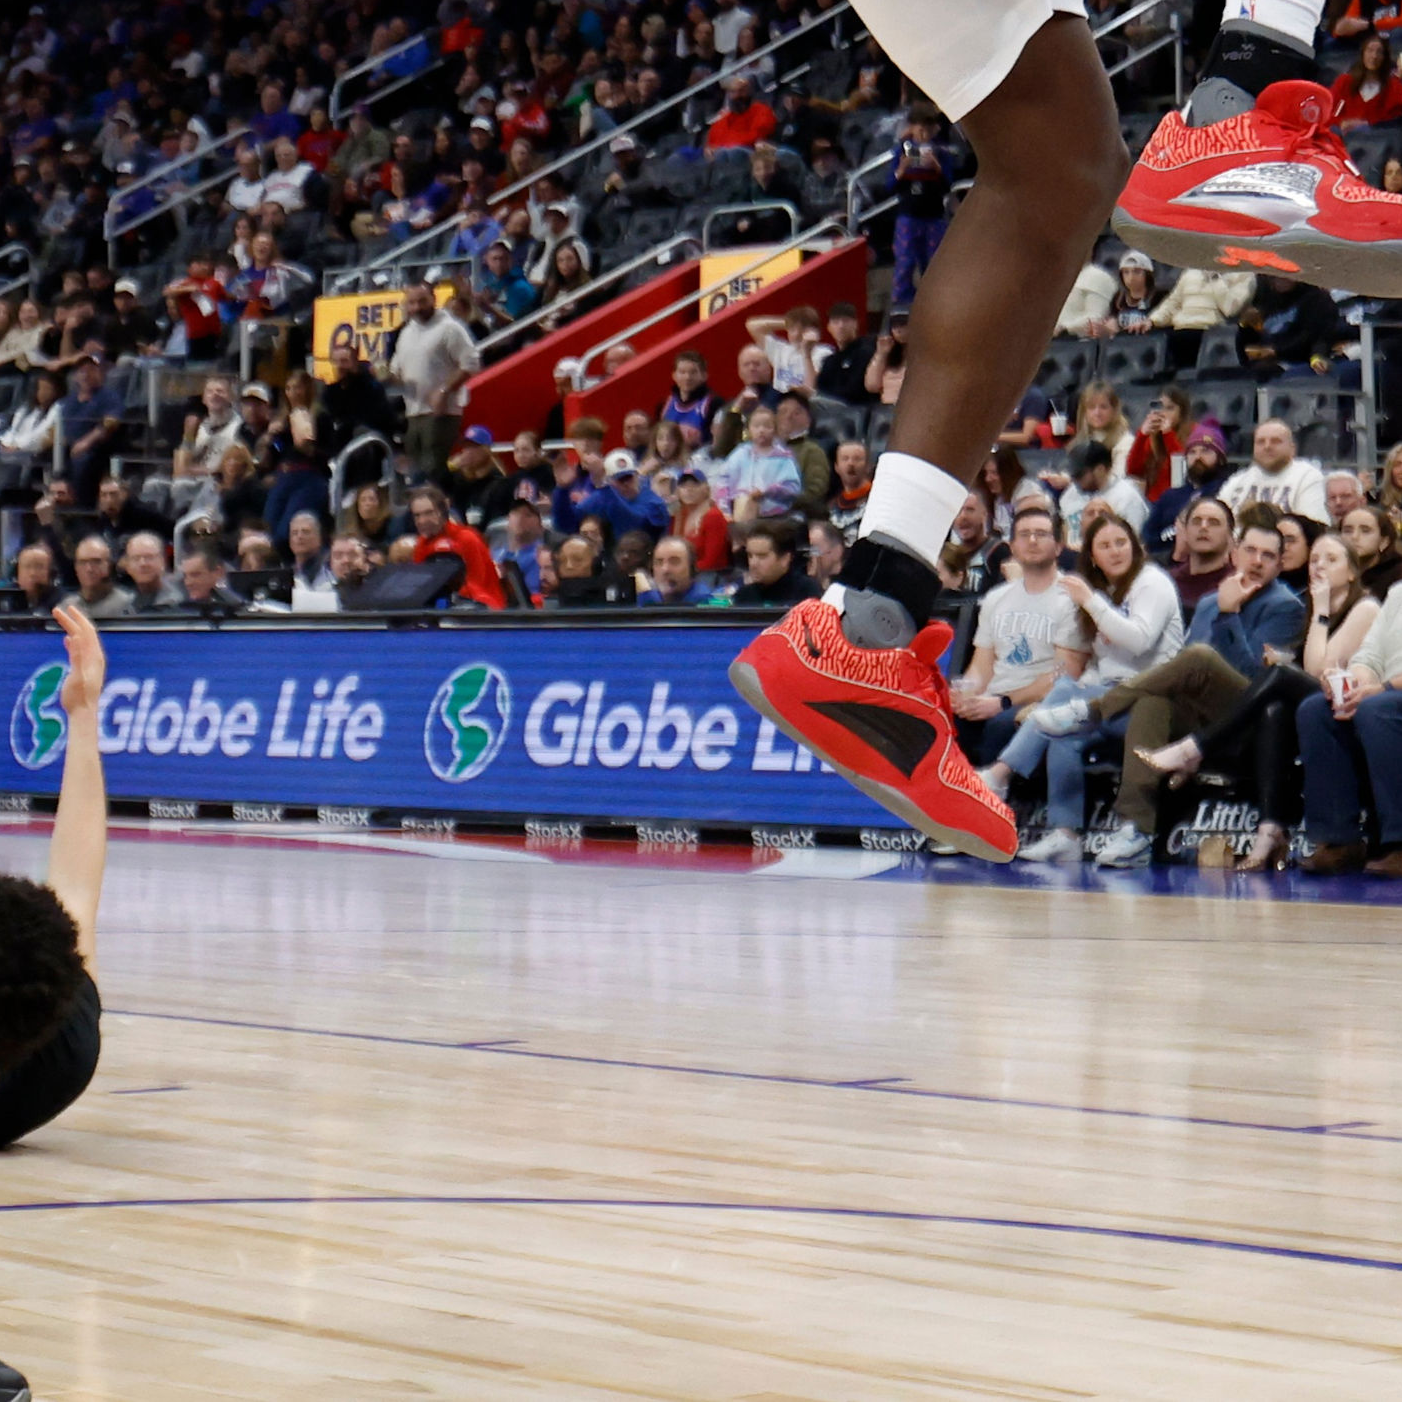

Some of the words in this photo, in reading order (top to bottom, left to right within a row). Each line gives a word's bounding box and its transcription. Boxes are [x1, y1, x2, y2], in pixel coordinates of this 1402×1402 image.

[729, 276, 763, 298] BET
[358, 302, 398, 327] BET
[98, 677, 258, 758] Globe
[267, 674, 385, 761] Life
[523, 681, 739, 772] Globe
[149, 801, 196, 819] StockX
[232, 805, 282, 823] StockX
[317, 808, 369, 827] StockX
[1191, 800, 1259, 832] Little
[524, 821, 582, 840] StockX
[636, 825, 698, 846] StockX
[751, 830, 815, 849] StockX
